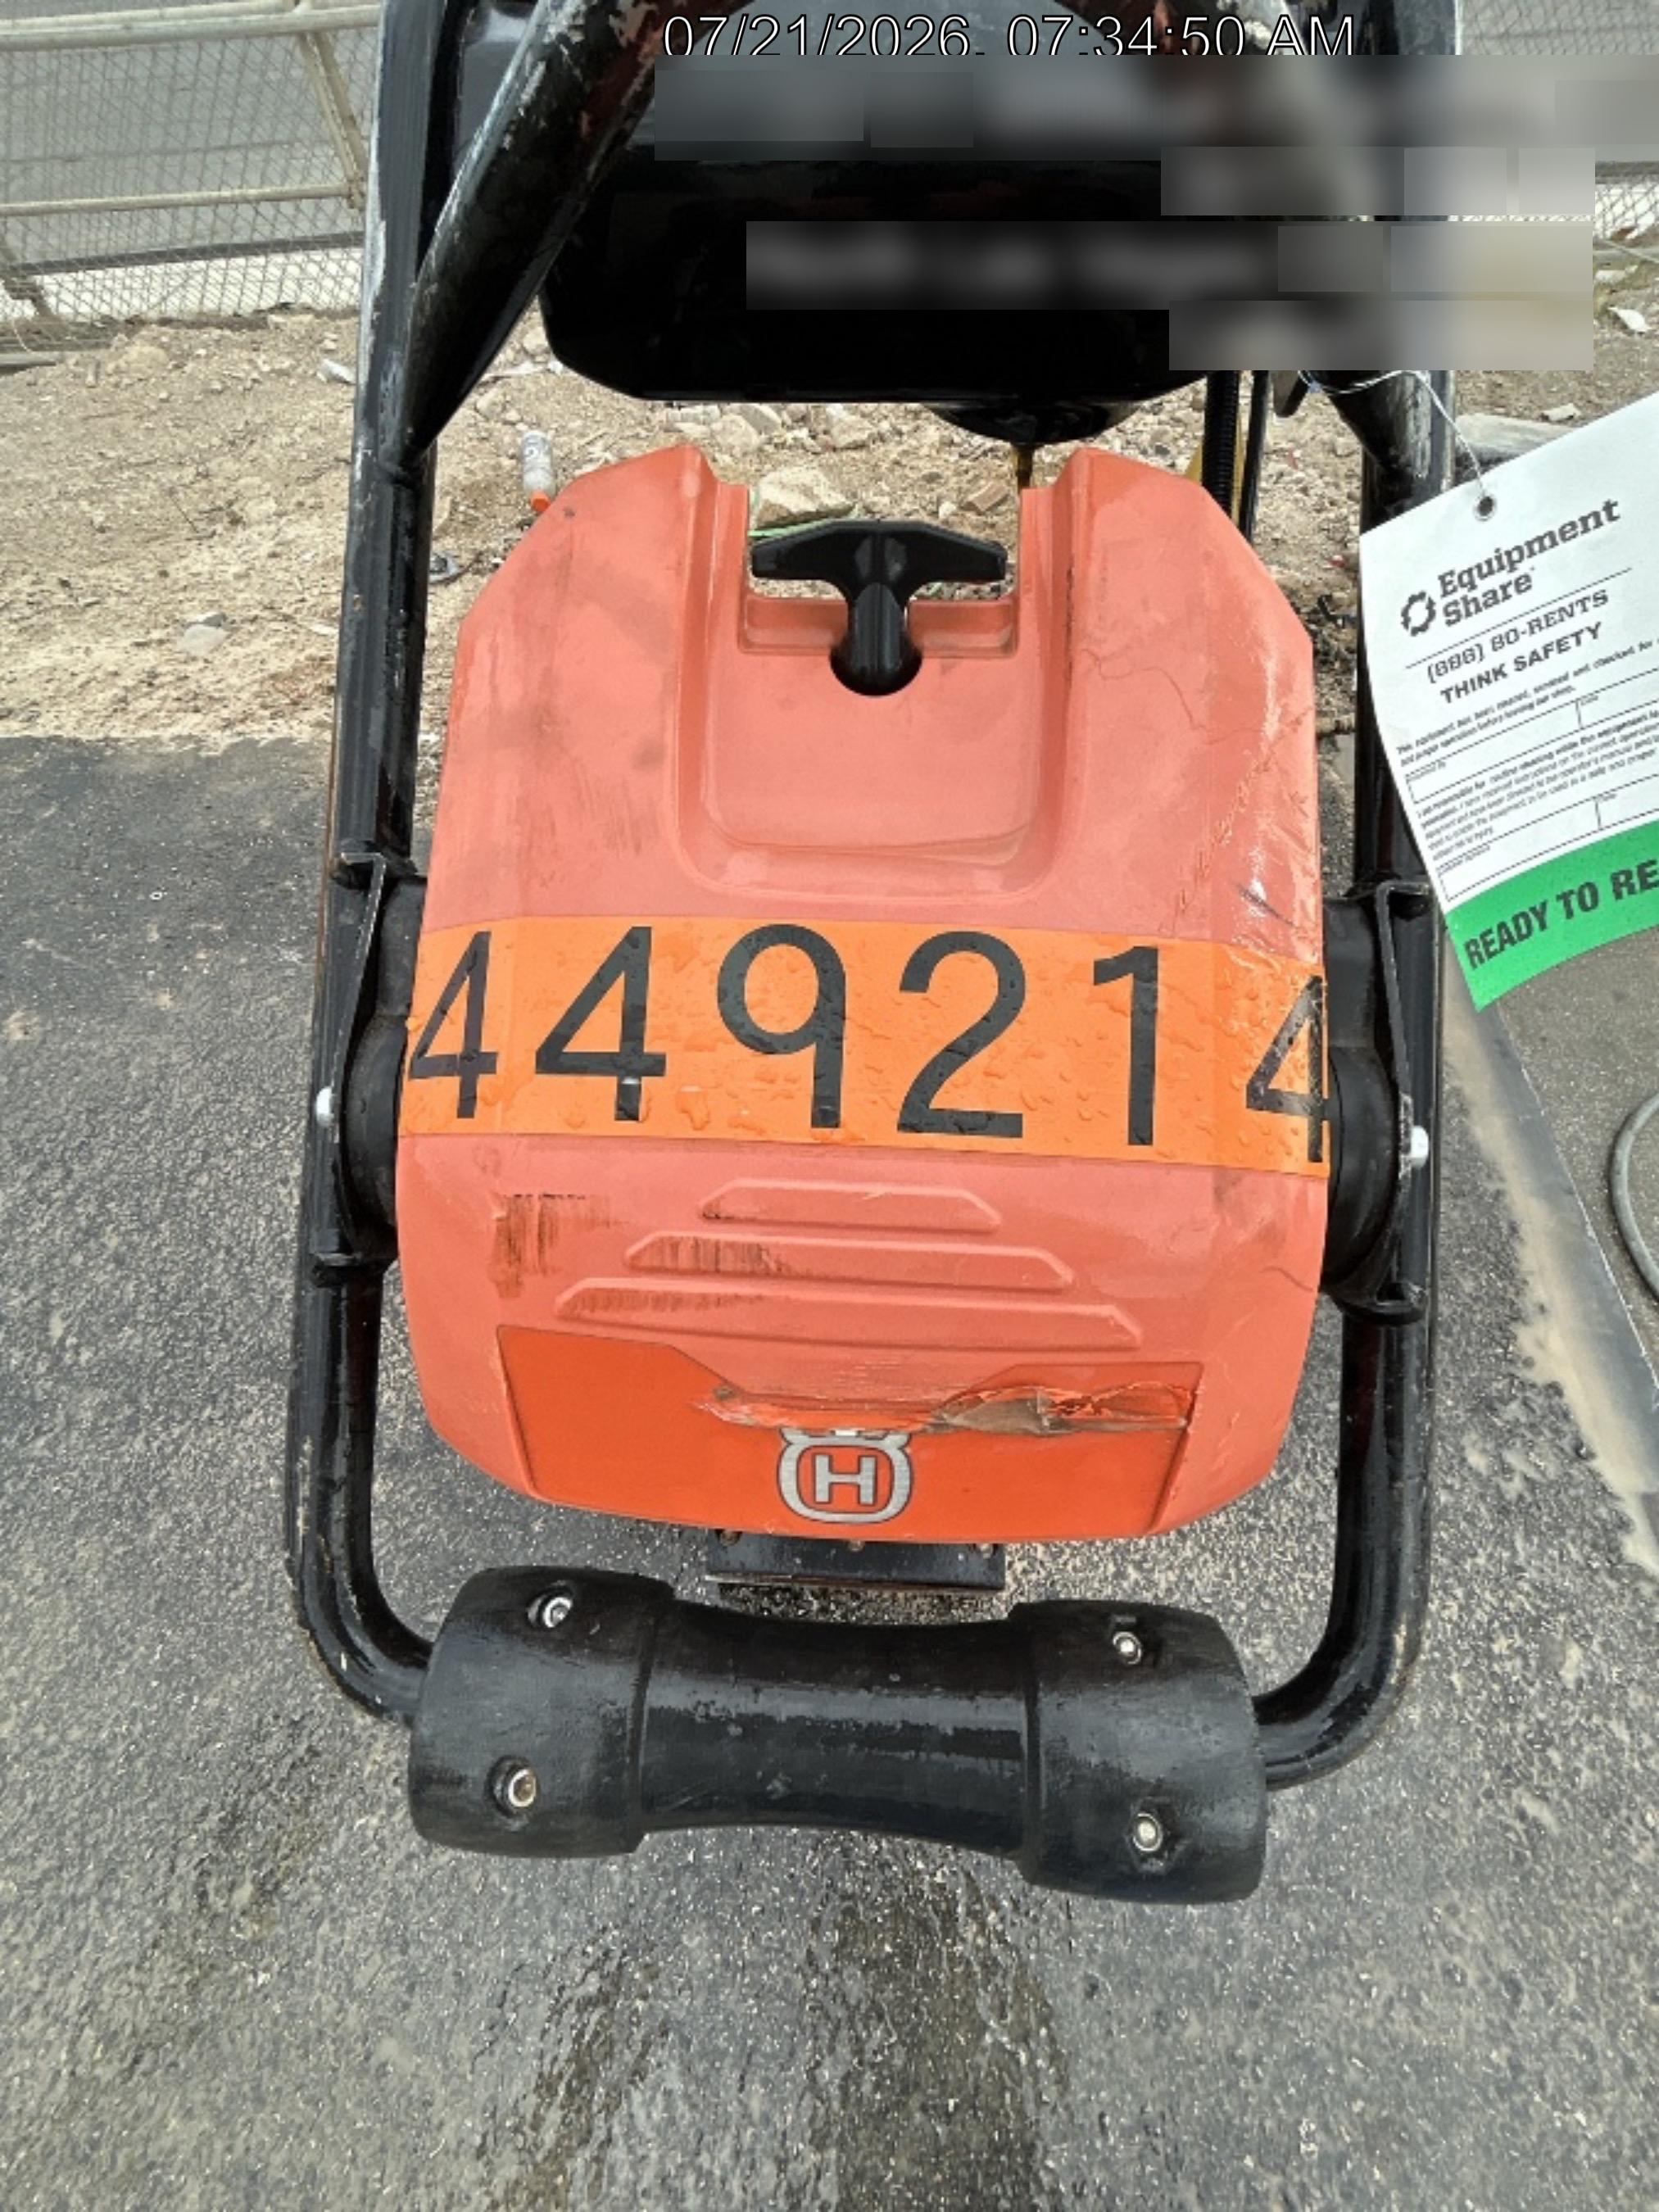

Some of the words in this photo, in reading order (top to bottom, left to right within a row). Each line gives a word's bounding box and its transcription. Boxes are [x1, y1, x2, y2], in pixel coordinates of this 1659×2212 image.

[1438, 499, 1621, 598] Equipment
[1443, 573, 1534, 627] Share
[1440, 663, 1508, 704] THINK
[1513, 621, 1602, 673] SAFETY
[1463, 900, 1549, 970] READY
[1557, 881, 1599, 920] TO
[408, 923, 1329, 1163] 449214
